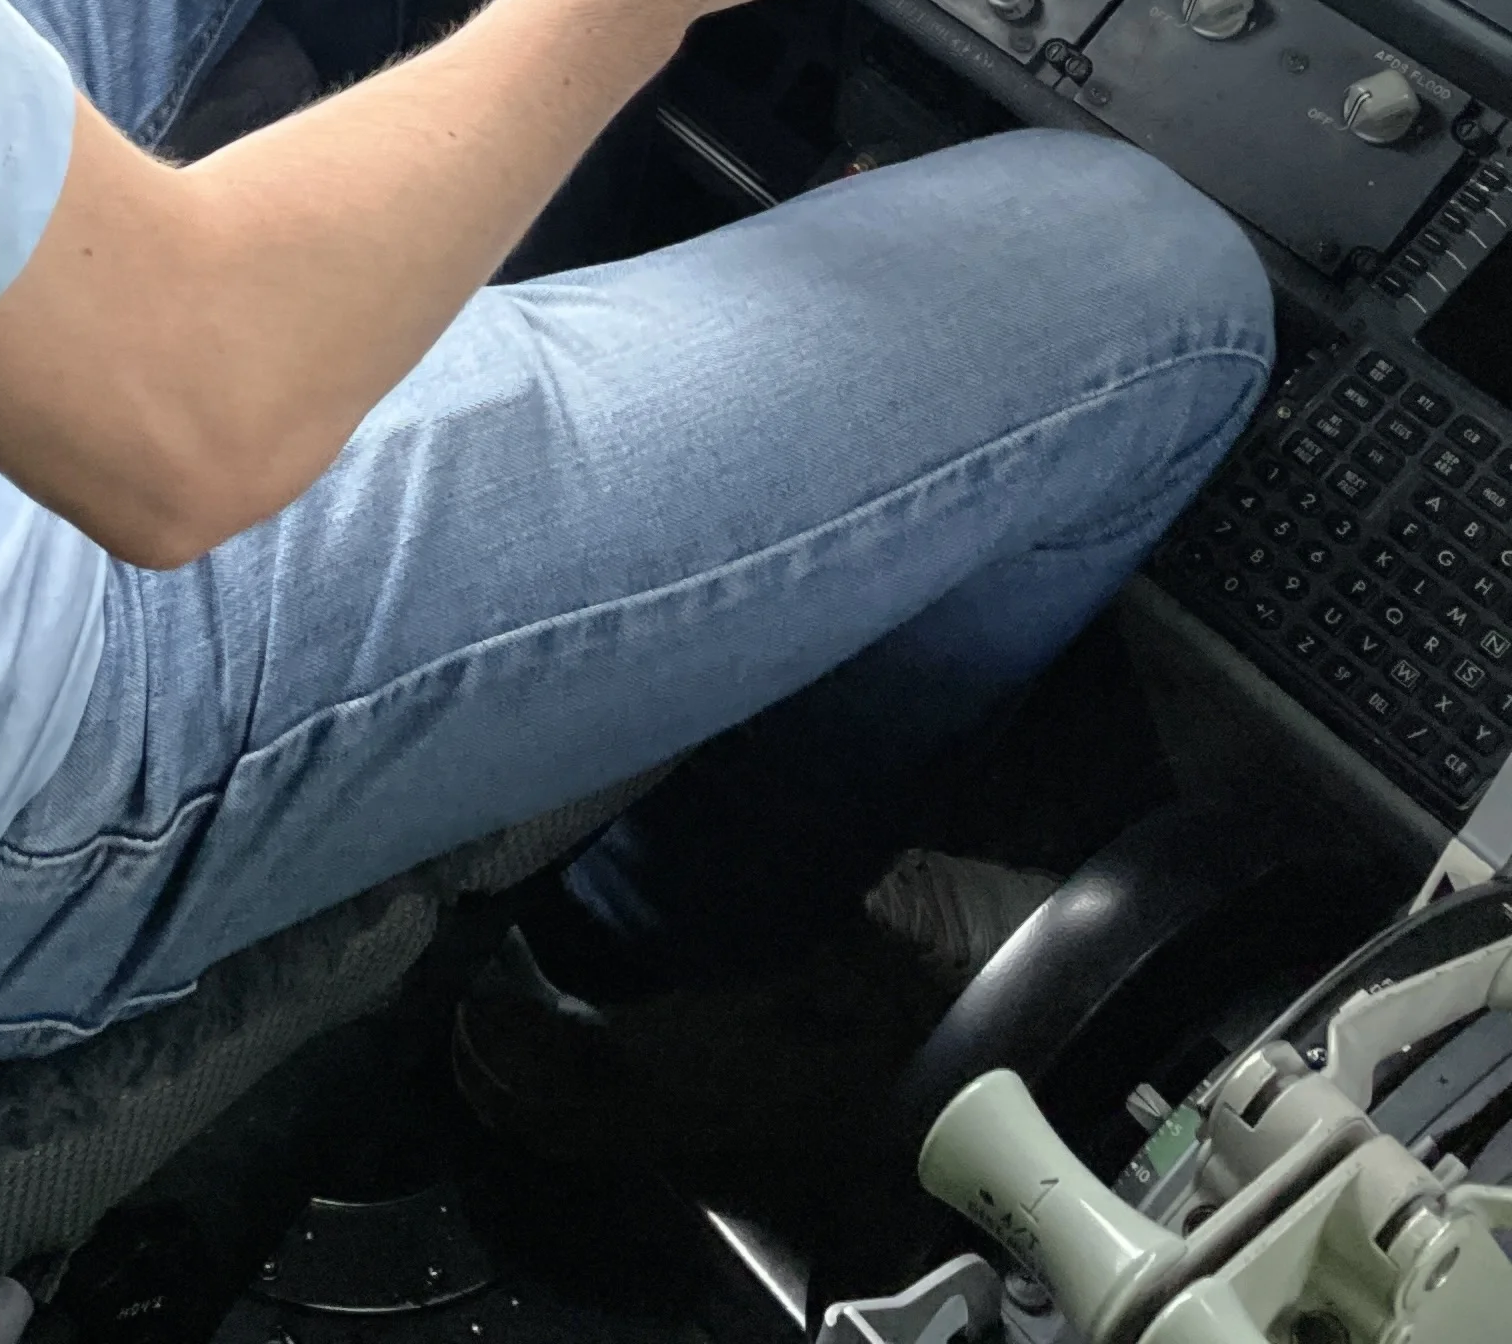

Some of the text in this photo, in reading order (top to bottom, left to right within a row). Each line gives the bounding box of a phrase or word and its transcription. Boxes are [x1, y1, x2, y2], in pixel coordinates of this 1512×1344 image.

[1373, 49, 1452, 100] AFDS FLOOD
[1307, 107, 1336, 126] OFF
[1390, 420, 1413, 440] LEGS
[1268, 468, 1279, 480] 1
[1241, 497, 1255, 508] 4
[1300, 493, 1316, 509] 2
[1425, 496, 1441, 512] A
[1482, 487, 1506, 507] HOLD
[1215, 520, 1232, 533] 7
[1273, 521, 1290, 535] 5
[1336, 520, 1351, 535] 3
[1402, 523, 1418, 537] F
[1464, 521, 1479, 537] B
[1250, 548, 1265, 563] 8
[1310, 550, 1326, 562] 6
[1375, 551, 1393, 568] K
[1438, 550, 1456, 566] G
[1224, 577, 1239, 591] 0
[1285, 576, 1301, 590] 9
[1351, 579, 1366, 593] P
[1413, 579, 1426, 595] L
[1474, 577, 1494, 596] H
[1325, 607, 1342, 625] U
[1386, 607, 1404, 625] Q
[1446, 607, 1467, 627] M
[1298, 636, 1315, 653] Z
[1363, 635, 1379, 651] V
[1423, 635, 1439, 653] R
[1487, 634, 1504, 654] N
[1396, 663, 1416, 682] W
[1461, 665, 1478, 683] S
[1368, 693, 1389, 714] DEL
[1435, 695, 1453, 712] X
[1476, 725, 1491, 741] Y
[1445, 754, 1468, 775] CLR
